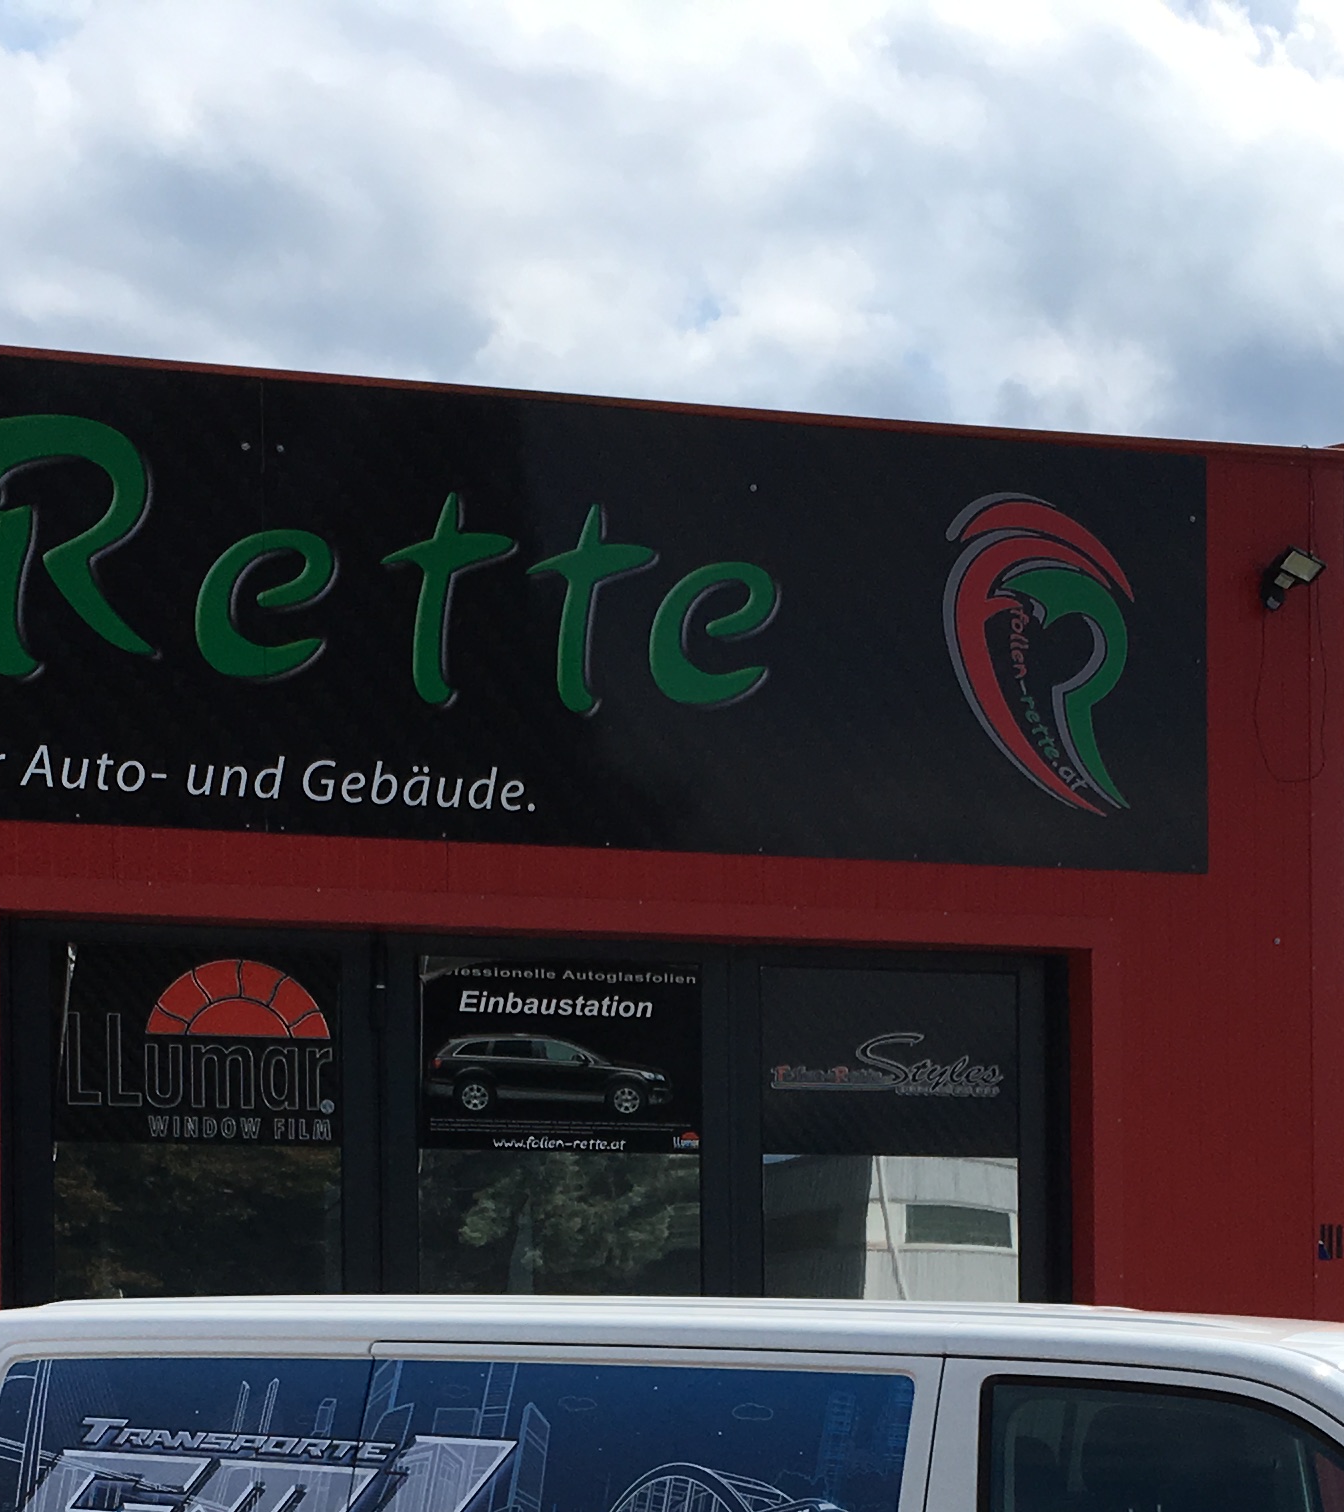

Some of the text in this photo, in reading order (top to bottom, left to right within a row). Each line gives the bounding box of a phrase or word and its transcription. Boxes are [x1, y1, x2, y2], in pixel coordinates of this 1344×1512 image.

[1008, 606, 1089, 793] folien-rette.at
[20, 744, 167, 793] Auto-
[186, 755, 286, 800] und
[302, 759, 537, 812] Gebäude.
[448, 966, 697, 985] fessionelle Autoglasfolien
[459, 990, 653, 1019] Einbaustation
[66, 1011, 333, 1111] LLumar
[855, 1032, 1004, 1091] Styles
[148, 1115, 332, 1141] WINDOW FILM
[493, 1135, 626, 1151] www.folien-rette.at
